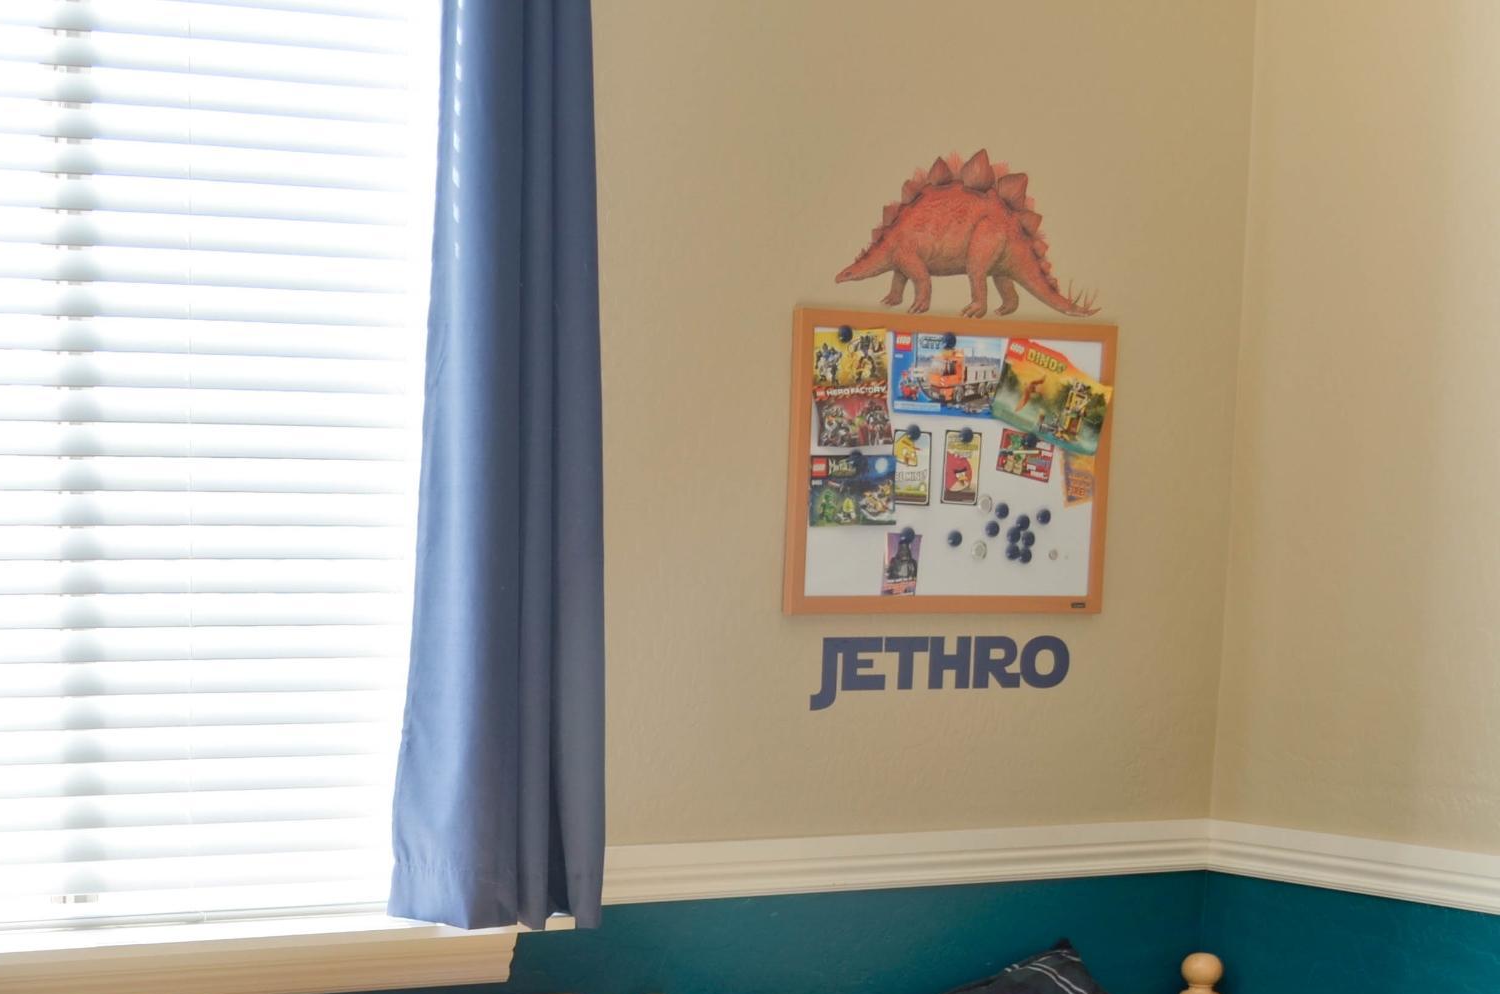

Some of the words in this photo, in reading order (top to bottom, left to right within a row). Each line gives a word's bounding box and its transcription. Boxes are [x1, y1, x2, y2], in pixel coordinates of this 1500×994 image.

[826, 387, 850, 397] HERO
[850, 385, 887, 395] FACTORY
[810, 635, 1070, 711] JETHRO
